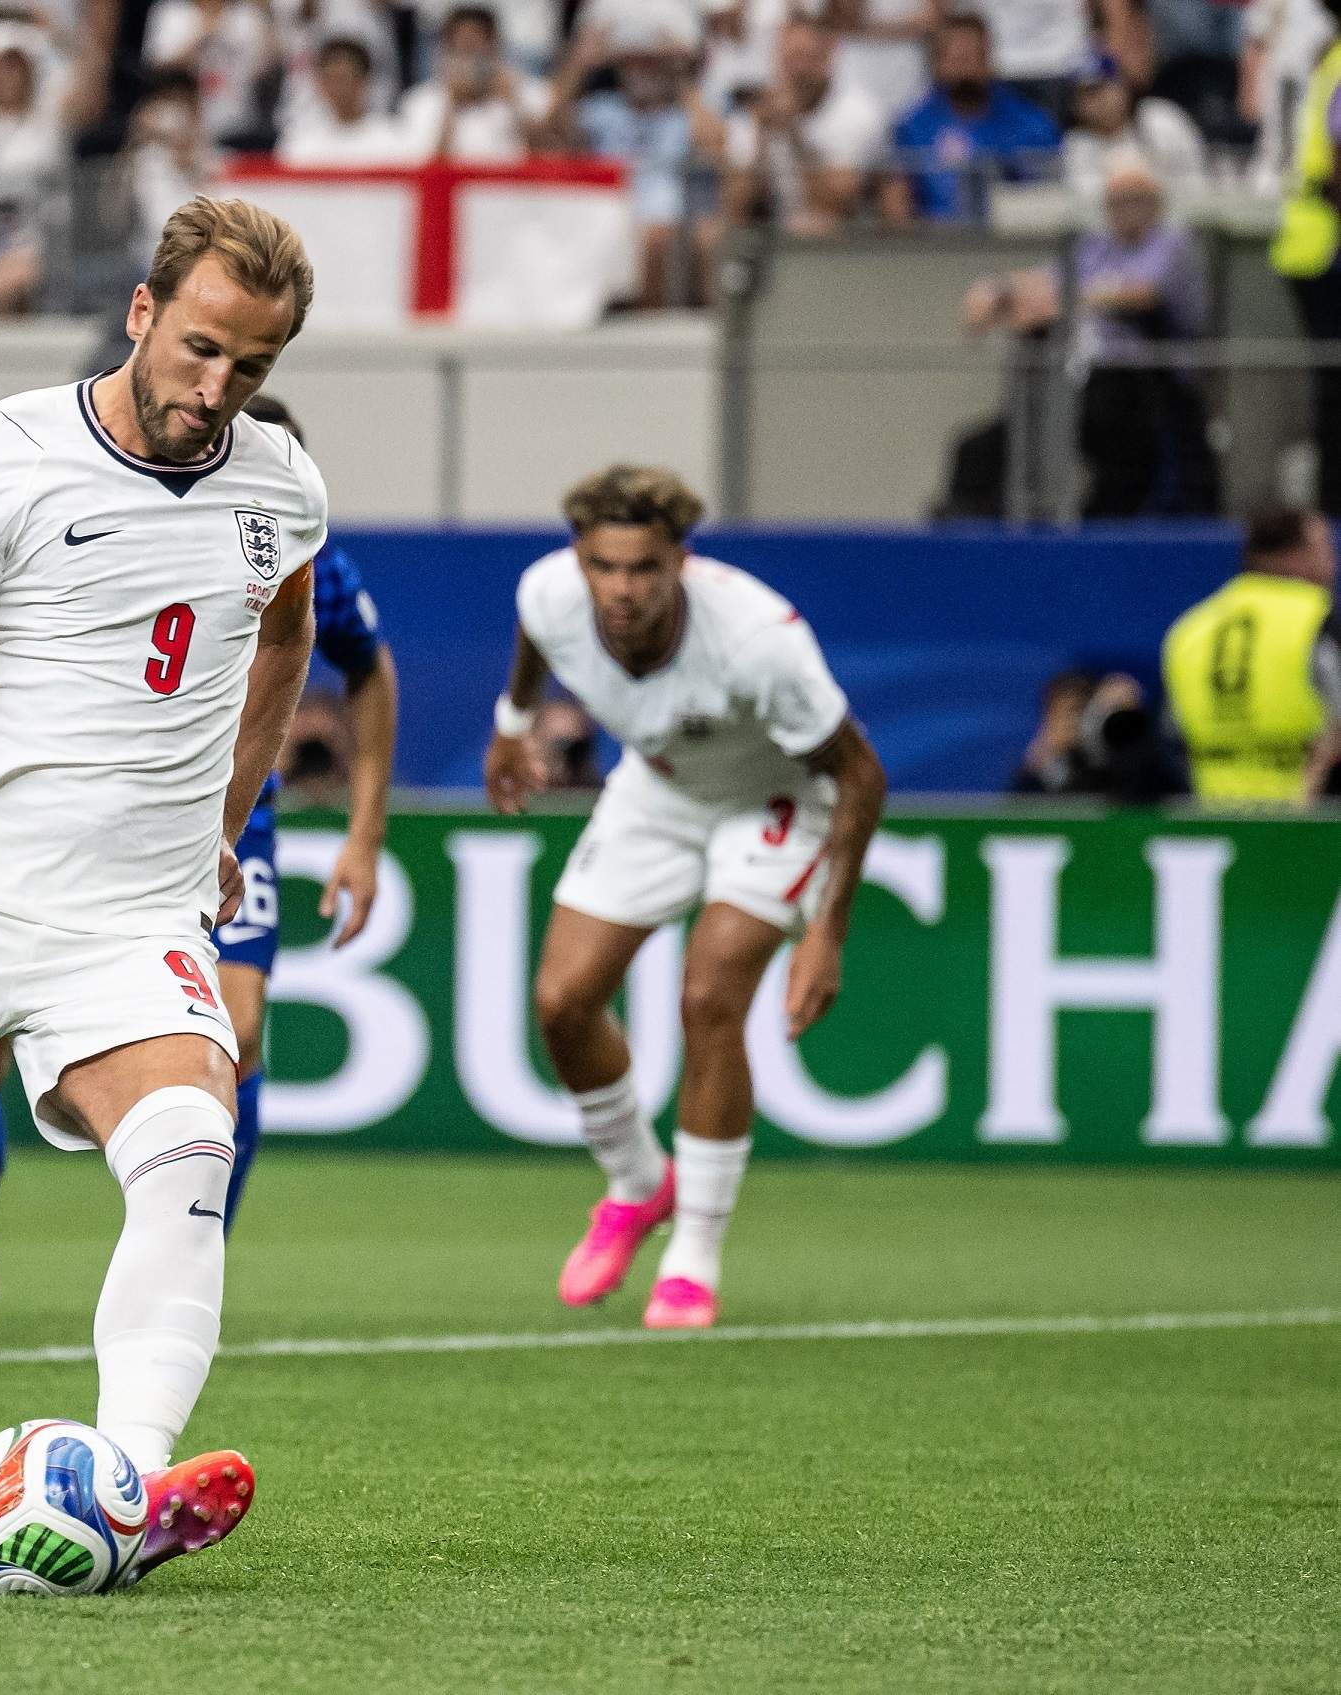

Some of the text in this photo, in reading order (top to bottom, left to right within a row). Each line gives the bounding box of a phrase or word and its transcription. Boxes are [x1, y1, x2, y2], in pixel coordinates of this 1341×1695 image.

[144, 602, 196, 696] 9
[762, 793, 795, 848] 3
[163, 950, 219, 1009] 9
